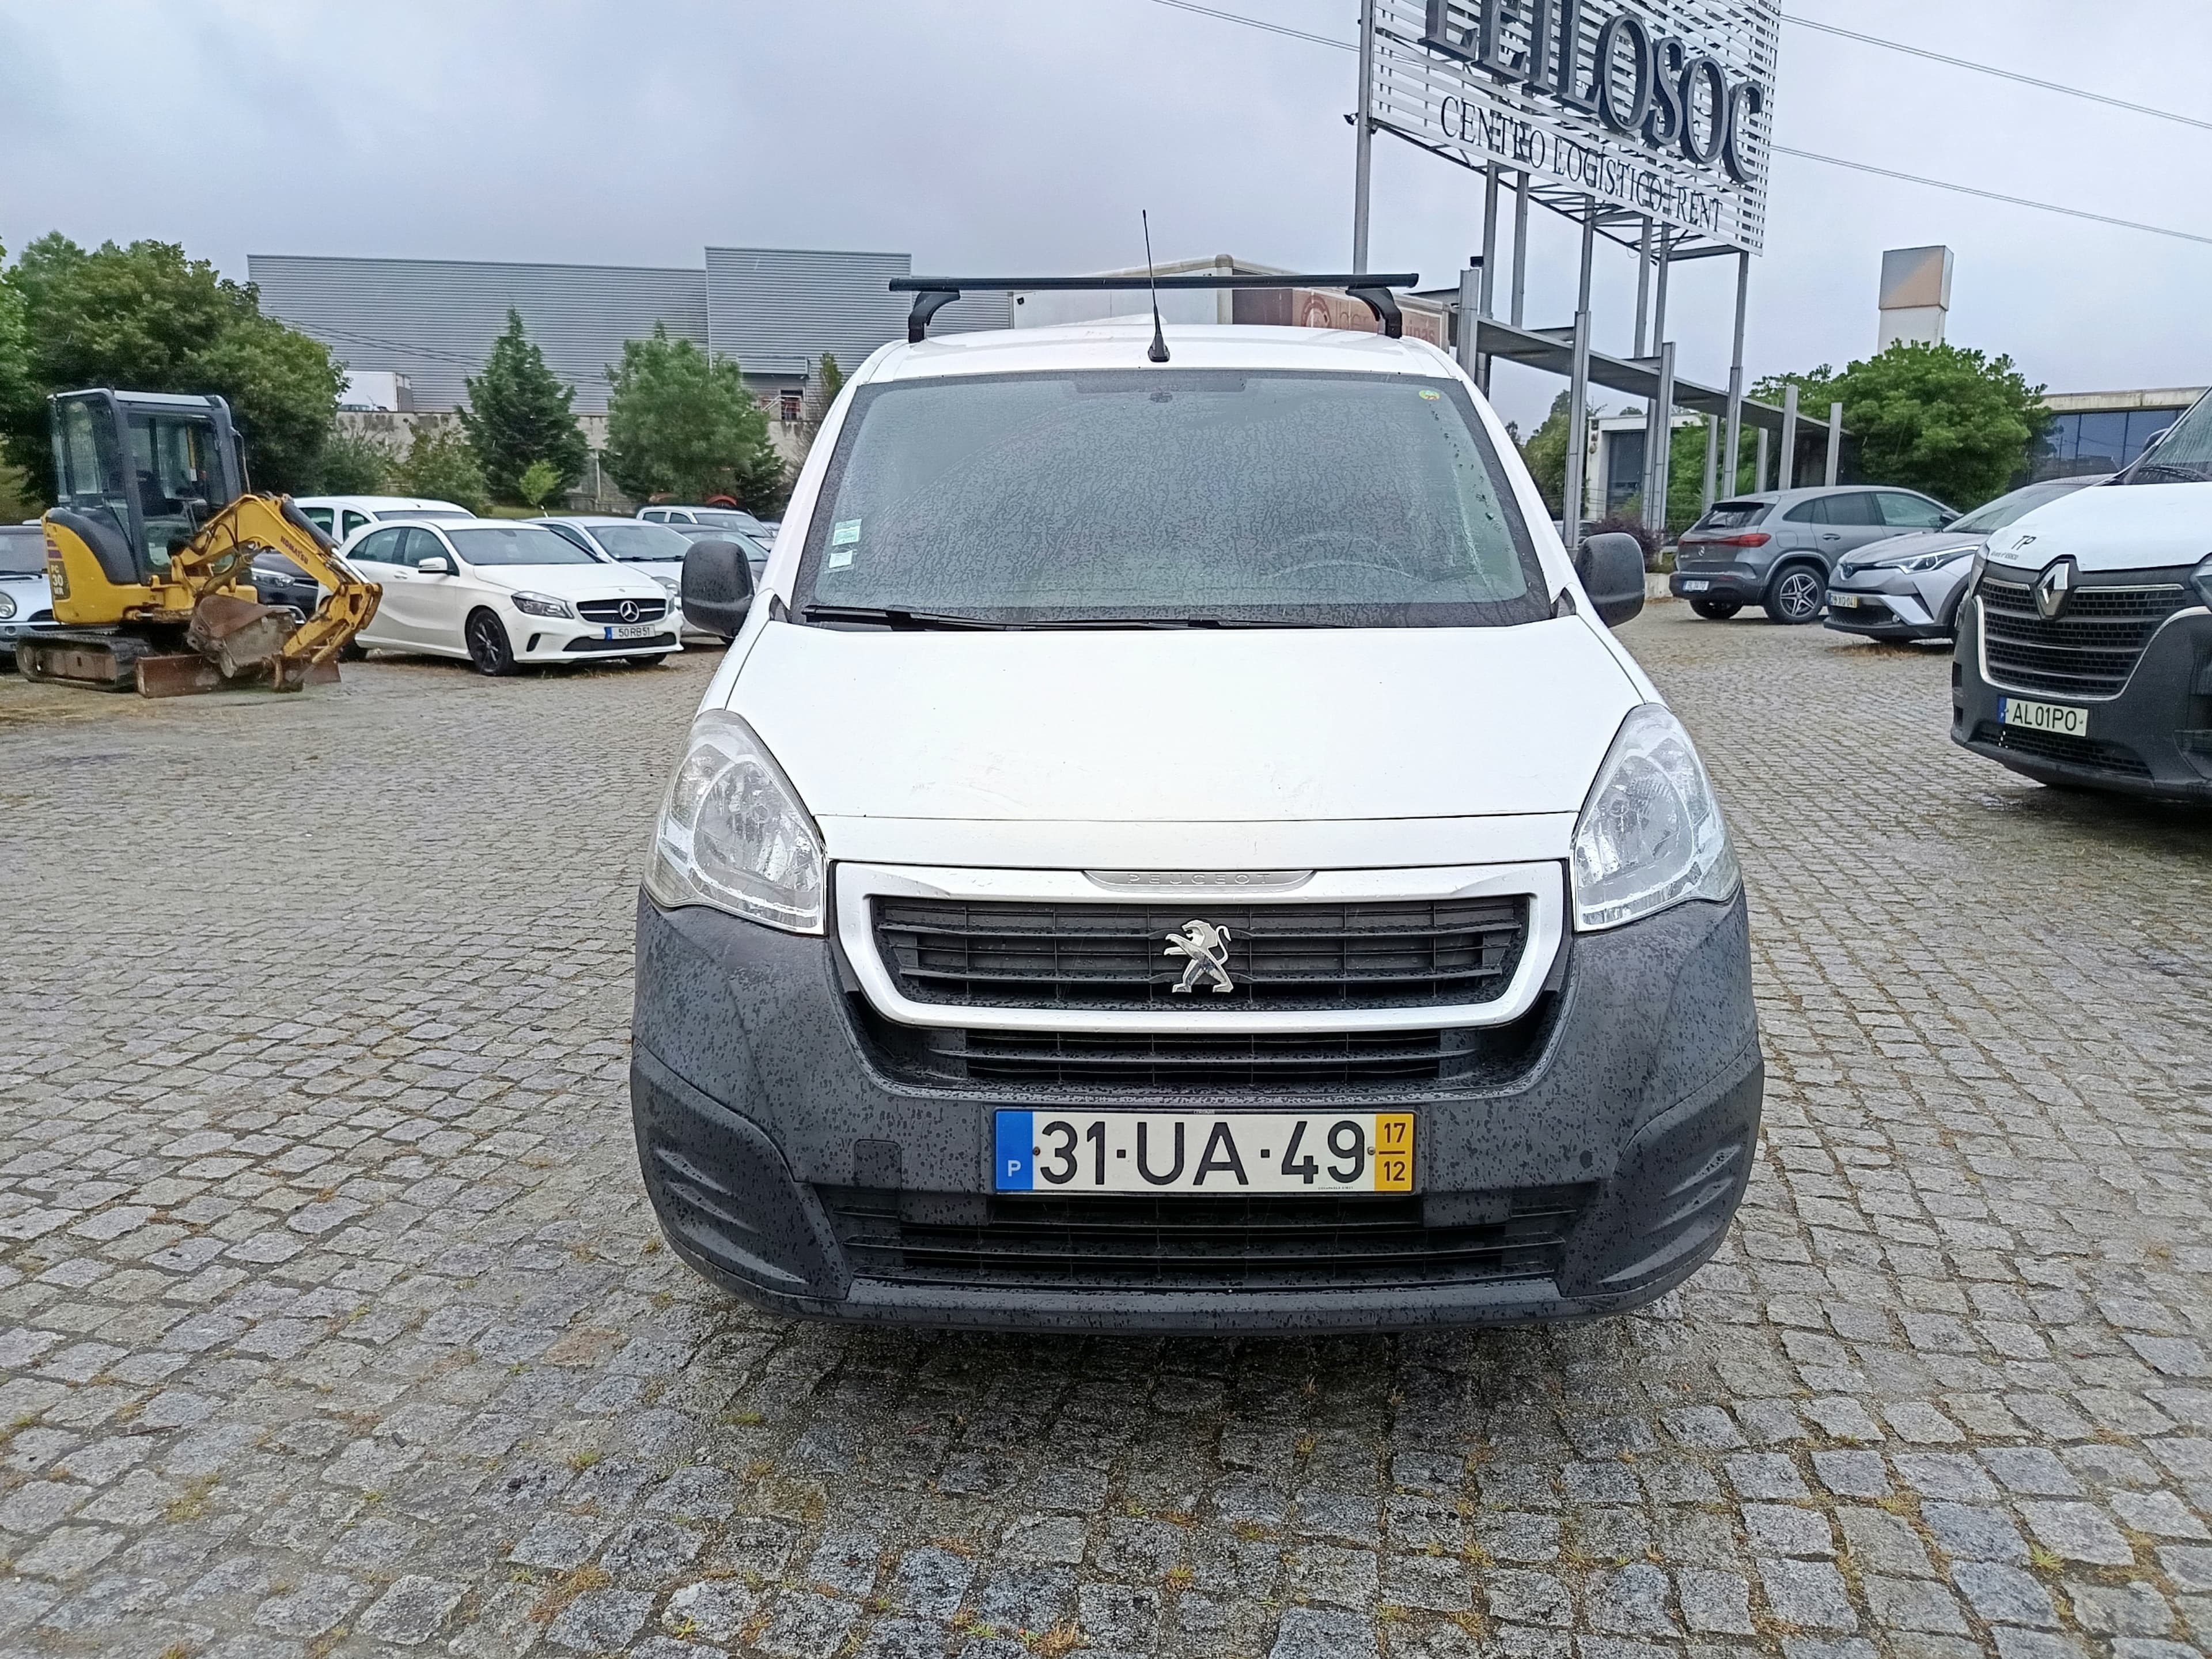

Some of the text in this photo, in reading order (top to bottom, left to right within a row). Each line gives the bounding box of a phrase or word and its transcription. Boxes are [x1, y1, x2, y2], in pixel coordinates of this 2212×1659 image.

[1441, 96, 1546, 169] CENTRO
[1674, 185, 1724, 233] RENT
[281, 535, 309, 565] KOMATSU
[2011, 535, 2037, 551] TP
[52, 574, 64, 586] 30
[1127, 874, 1270, 885] PEUGEOT
[1384, 1122, 1407, 1143] 17
[1007, 1160, 1022, 1177] P
[1384, 1160, 1406, 1181] 12
